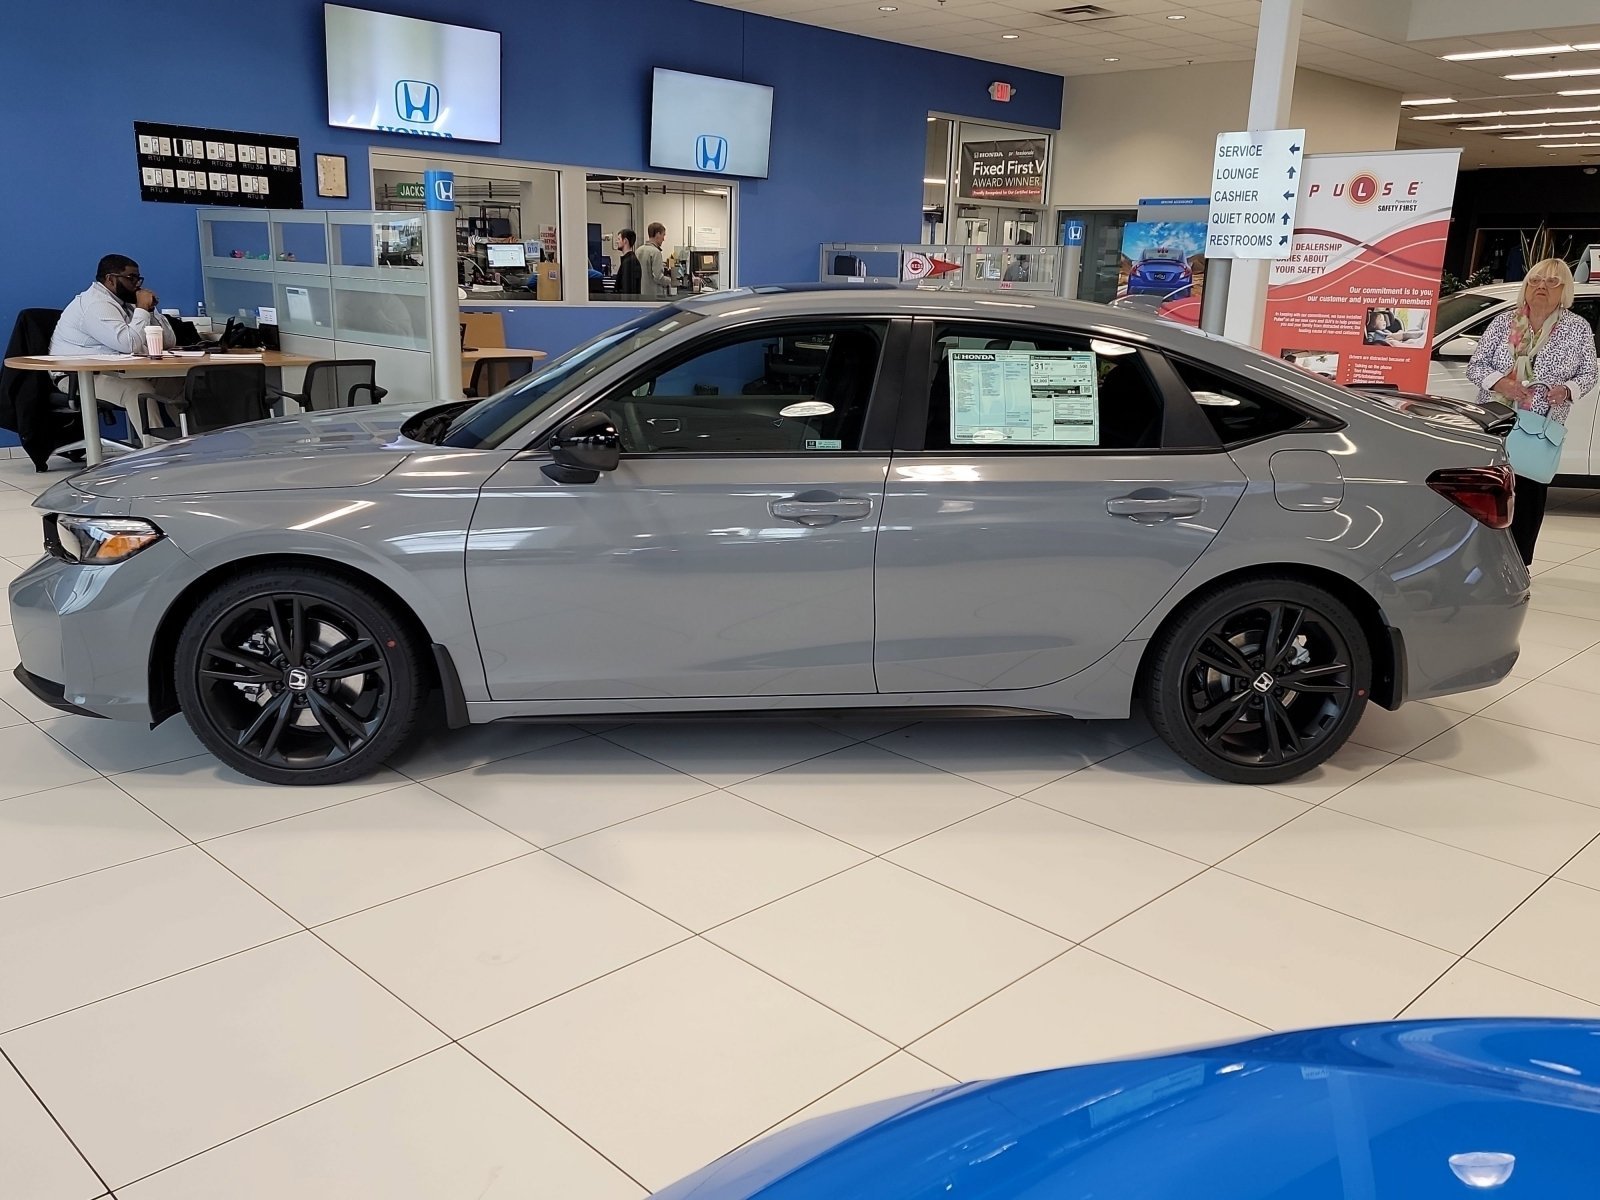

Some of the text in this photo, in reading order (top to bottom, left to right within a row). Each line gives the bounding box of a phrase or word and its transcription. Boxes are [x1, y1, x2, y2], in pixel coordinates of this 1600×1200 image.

[1219, 145, 1262, 157] SERVICE
[973, 160, 1005, 176] Fixed
[1007, 160, 1034, 175] First
[1216, 167, 1259, 180] LOUNGE
[972, 176, 1040, 188] AWARD WINNER
[1309, 181, 1419, 198] PULSE
[1214, 190, 1258, 202] CASHIER
[1212, 212, 1275, 225] QUIET ROOM
[1209, 234, 1273, 246] RESTROOMS
[1296, 243, 1342, 251] DEALERSHIP
[1303, 254, 1329, 263] ABOUT
[1275, 266, 1326, 274] YOUR SAFETY
[1349, 286, 1361, 294] Our
[1362, 286, 1403, 295] commitment
[1404, 287, 1411, 295] is
[1319, 295, 1347, 303] customer
[1349, 295, 1361, 303] and
[1362, 297, 1377, 305] your
[1378, 296, 1398, 305] family
[1400, 298, 1432, 306] members!
[1034, 362, 1044, 370] 31
